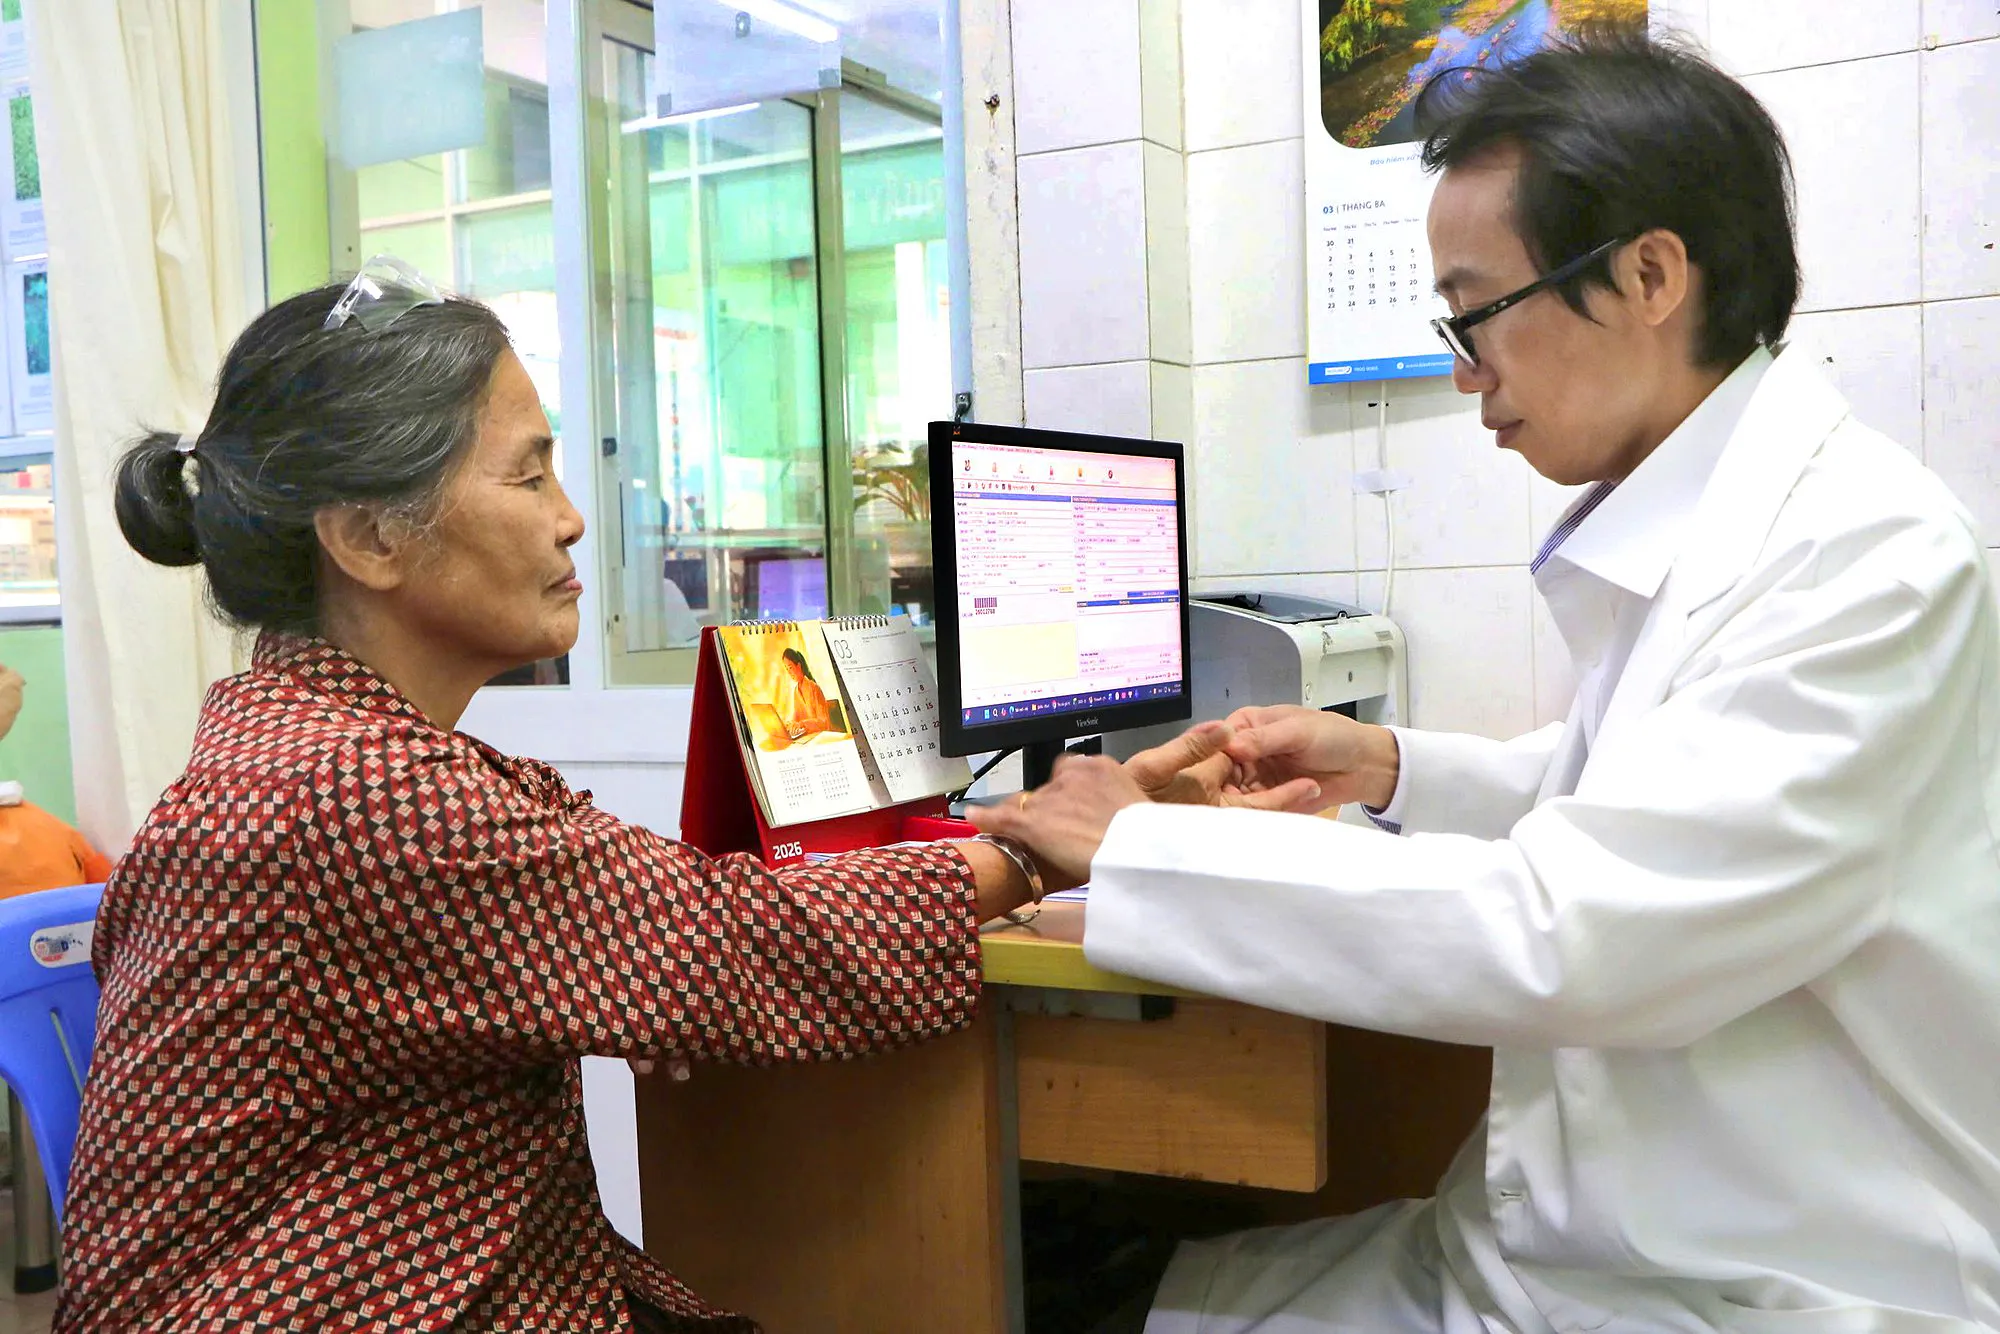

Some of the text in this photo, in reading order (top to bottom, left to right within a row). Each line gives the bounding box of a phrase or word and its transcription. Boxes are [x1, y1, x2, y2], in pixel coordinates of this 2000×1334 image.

[1323, 206, 1334, 214] 03
[1375, 200, 1386, 208] BA
[834, 640, 852, 659] 03
[1076, 717, 1099, 727] ViewSonic
[773, 841, 802, 860] 2026
